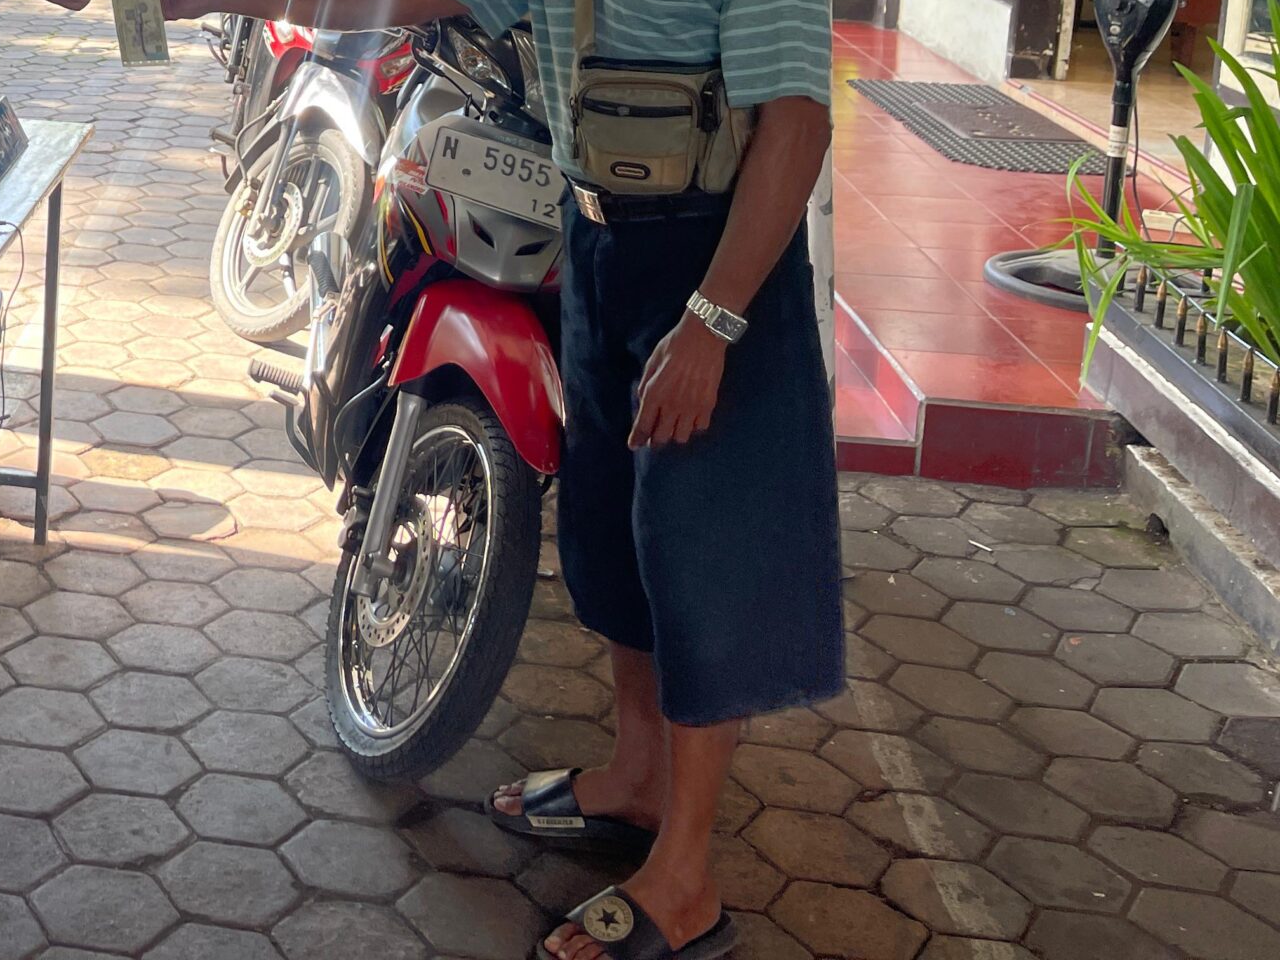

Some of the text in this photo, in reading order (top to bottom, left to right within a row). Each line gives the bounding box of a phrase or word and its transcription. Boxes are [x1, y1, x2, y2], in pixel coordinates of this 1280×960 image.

[442, 136, 459, 159] N
[483, 146, 552, 187] 5955
[532, 199, 556, 218] 12
